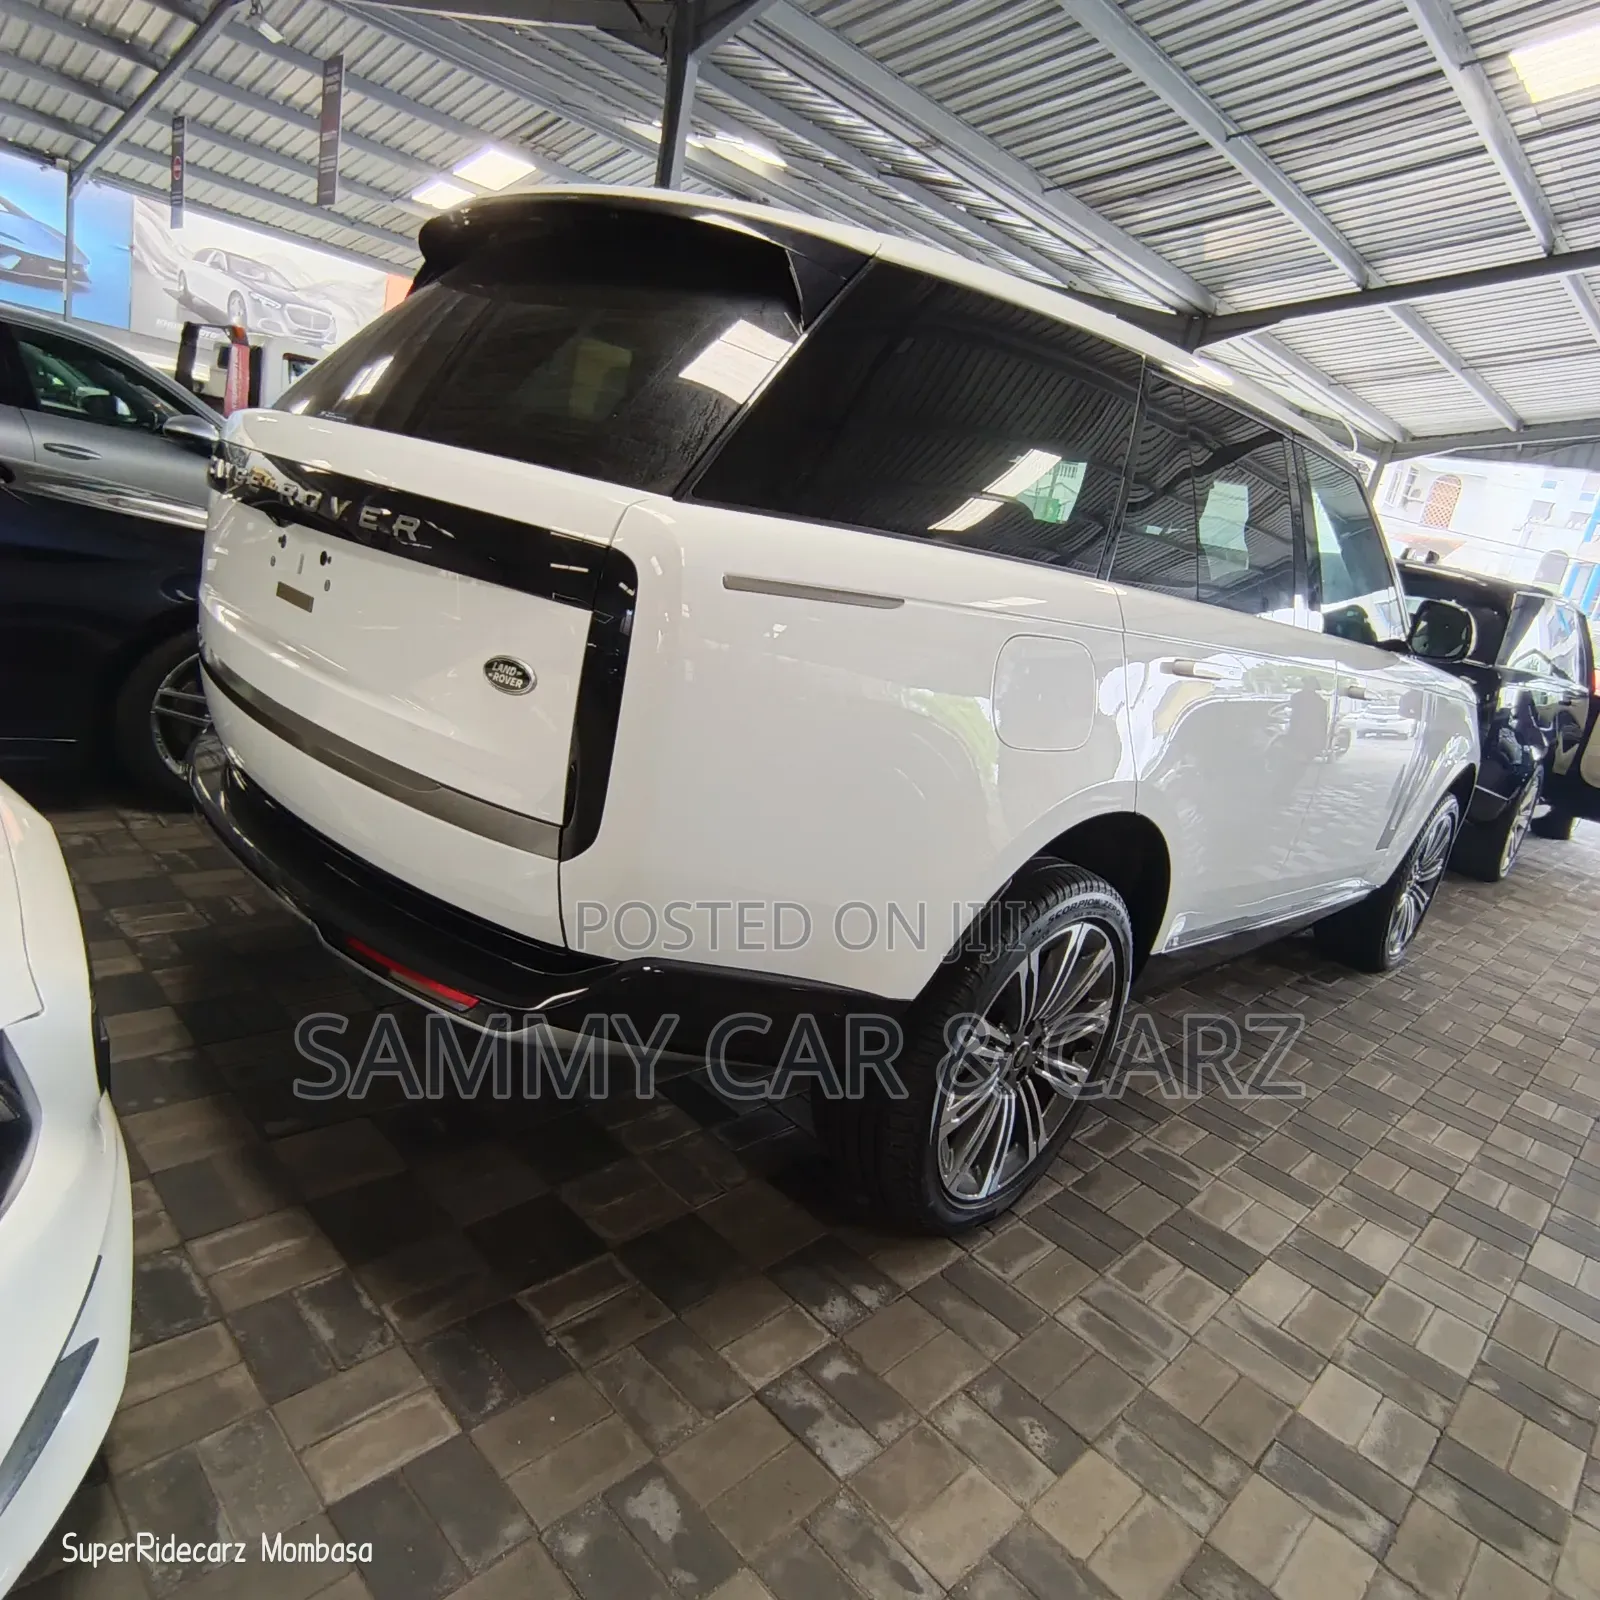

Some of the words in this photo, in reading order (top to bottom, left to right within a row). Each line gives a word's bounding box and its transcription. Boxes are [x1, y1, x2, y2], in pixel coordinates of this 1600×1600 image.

[278, 482, 421, 542] ROVER
[491, 661, 517, 676] LAND
[492, 671, 524, 688] ROVER
[1047, 898, 1102, 925] SCORPION
